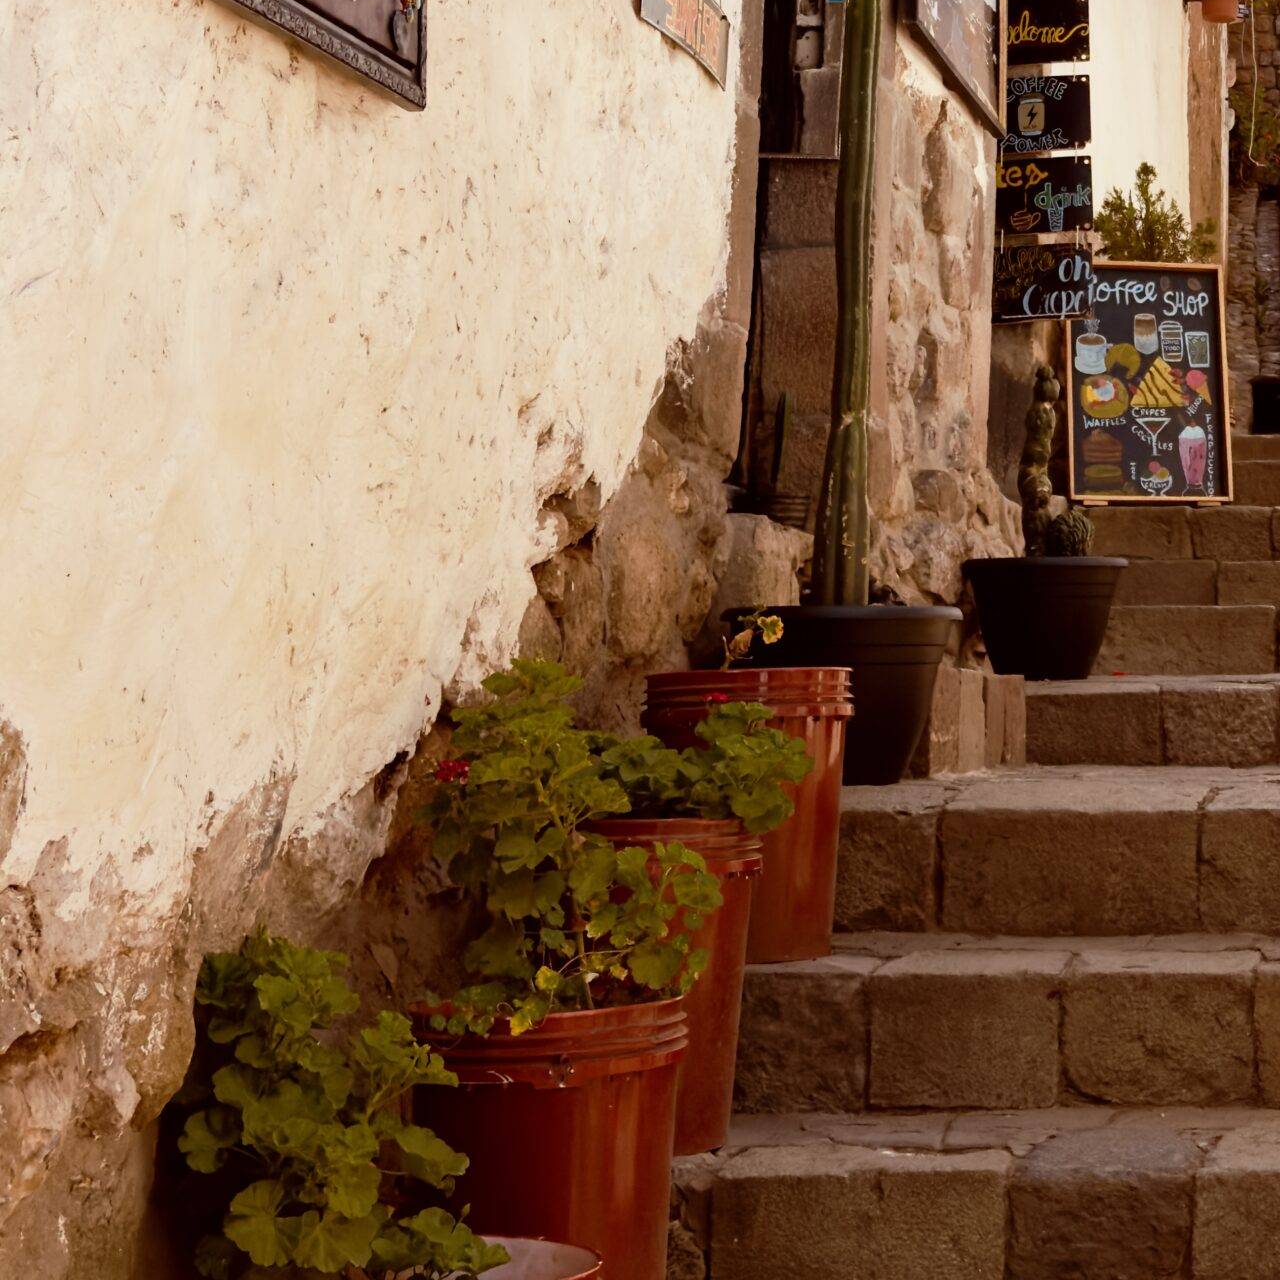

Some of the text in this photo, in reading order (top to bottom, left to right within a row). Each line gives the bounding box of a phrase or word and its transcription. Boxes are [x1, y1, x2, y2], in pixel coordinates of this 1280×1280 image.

[1001, 128, 1069, 153] POWER
[1163, 291, 1209, 316] SHOP
[1082, 415, 1127, 430] WAFFLES
